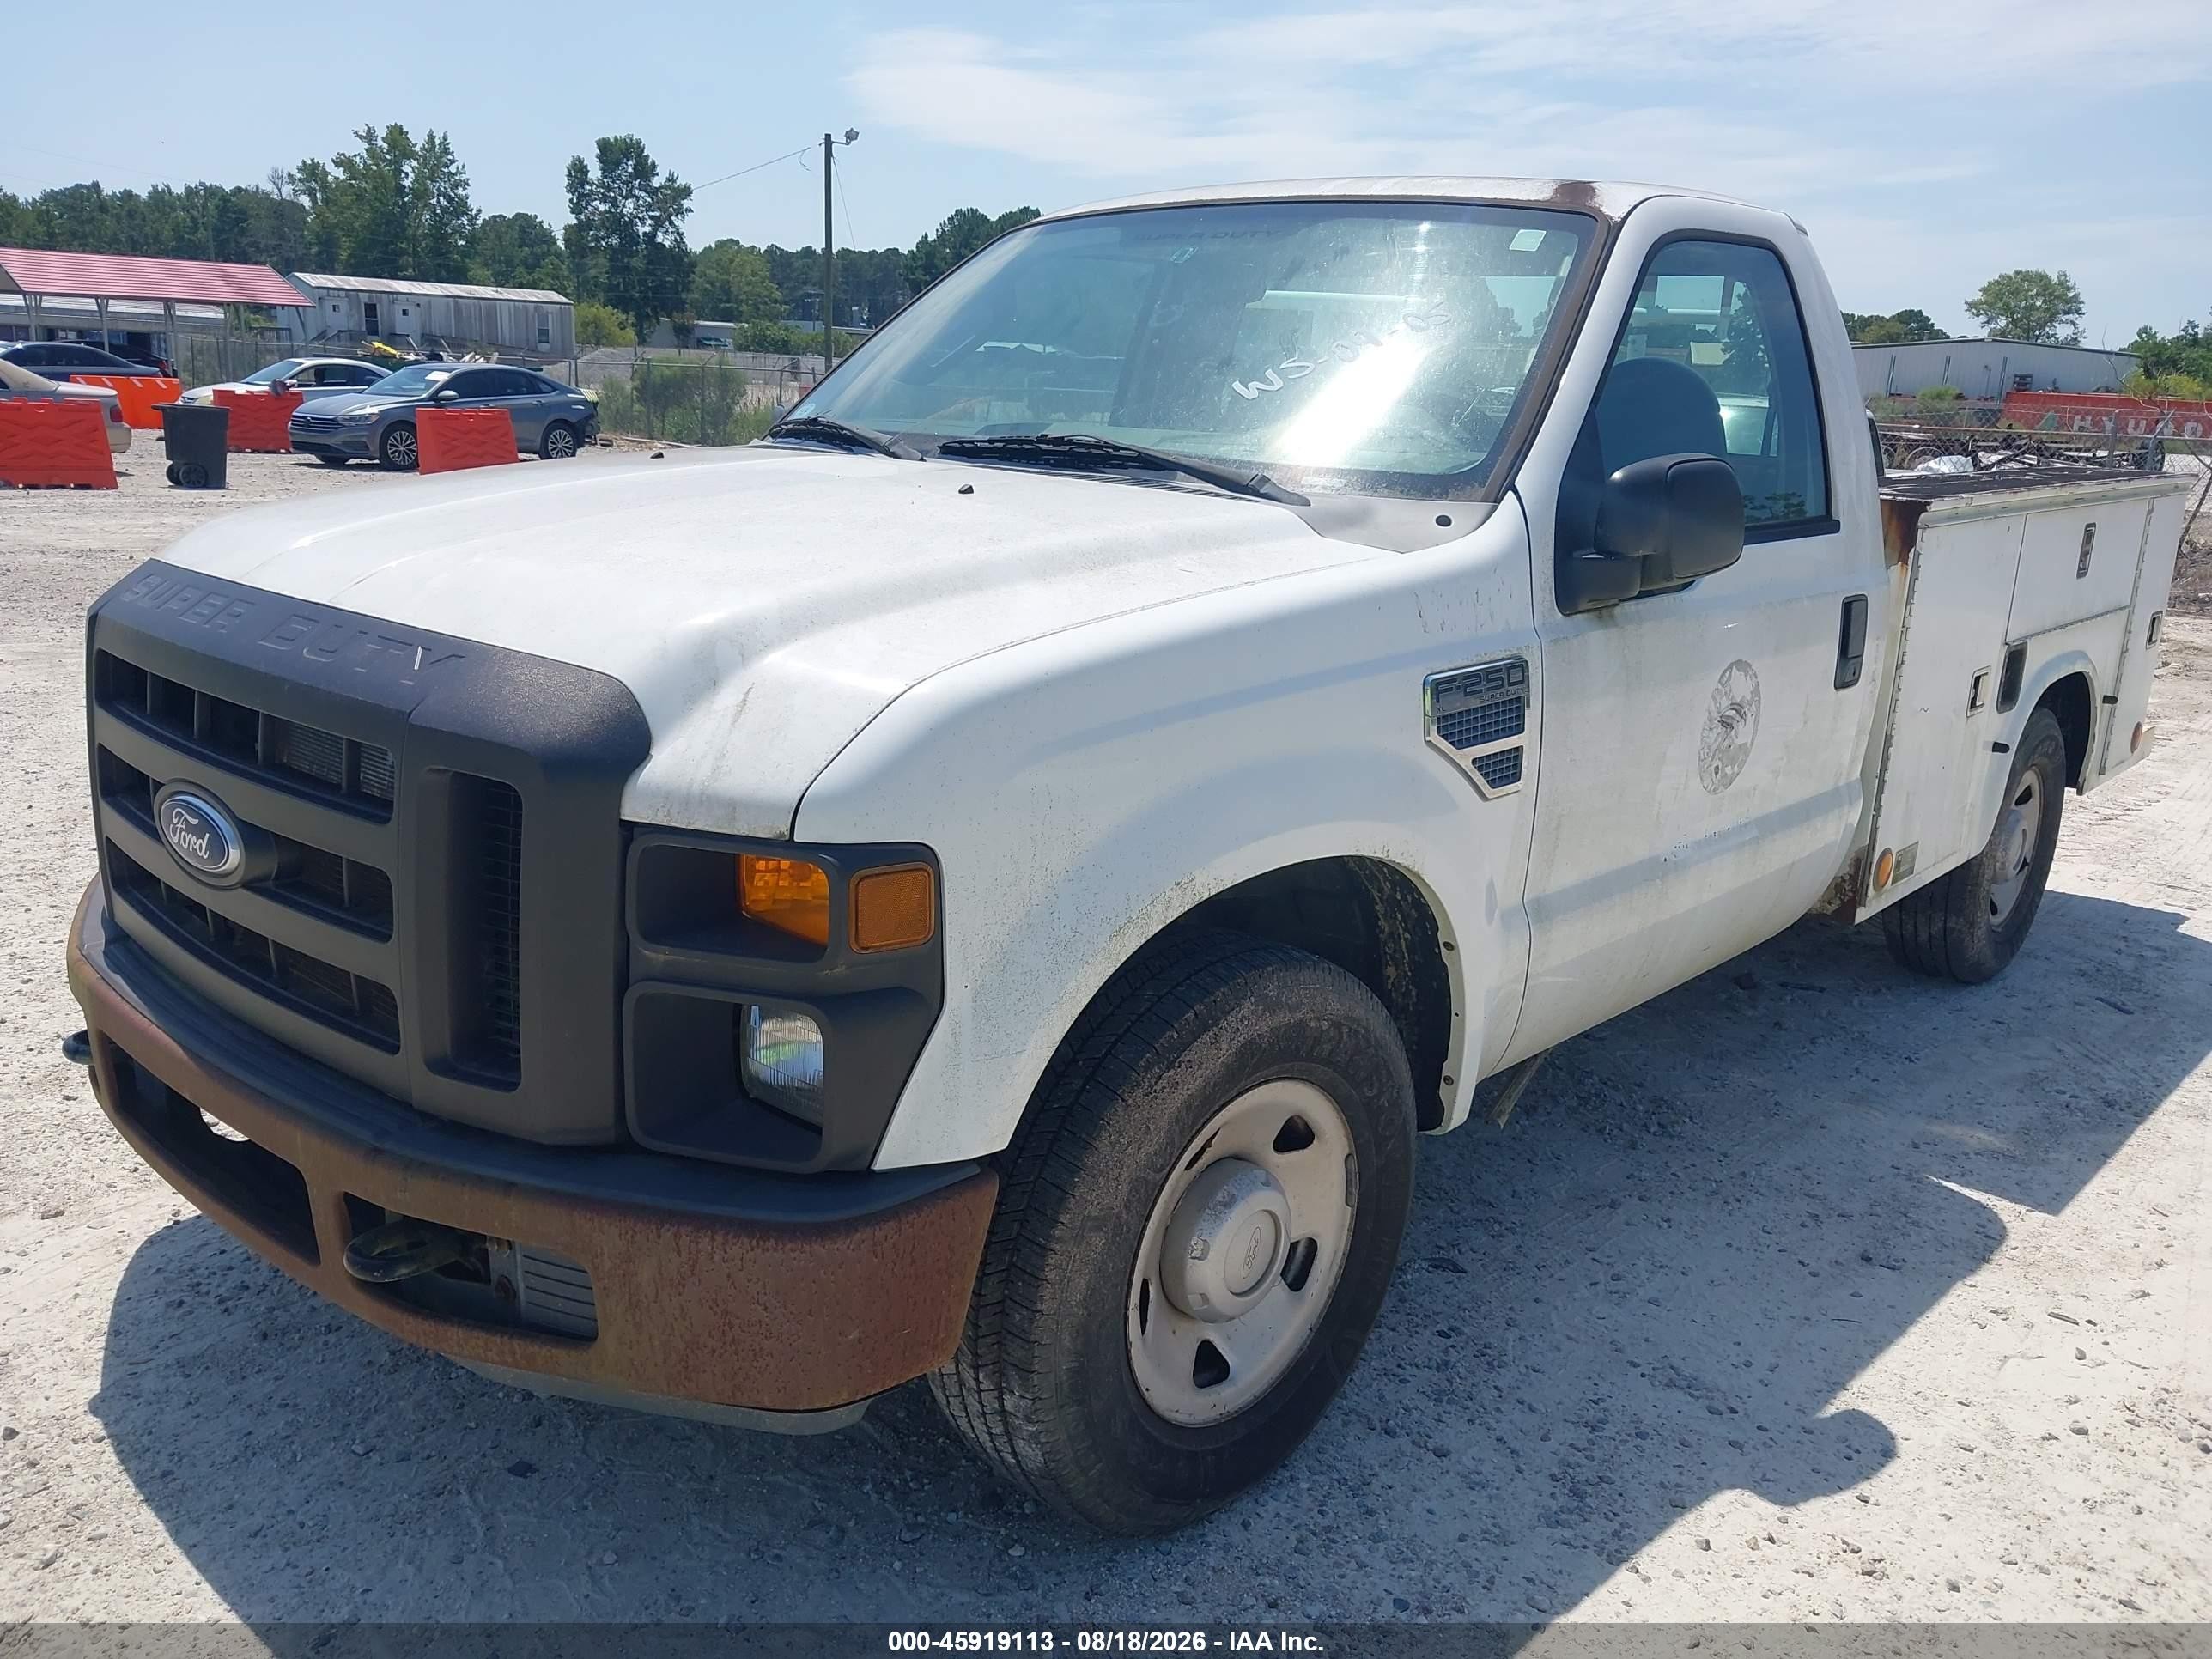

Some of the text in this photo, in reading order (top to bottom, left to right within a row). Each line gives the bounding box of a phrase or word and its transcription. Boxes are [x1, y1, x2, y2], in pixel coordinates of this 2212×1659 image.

[1209, 230, 1282, 240] DUTY
[121, 572, 466, 686] SUPER DUTY
[1435, 663, 1525, 704] F-250
[1480, 686, 1525, 703] SUPER DUTY
[169, 807, 210, 860] Ford
[1244, 1237, 1260, 1270] Ford
